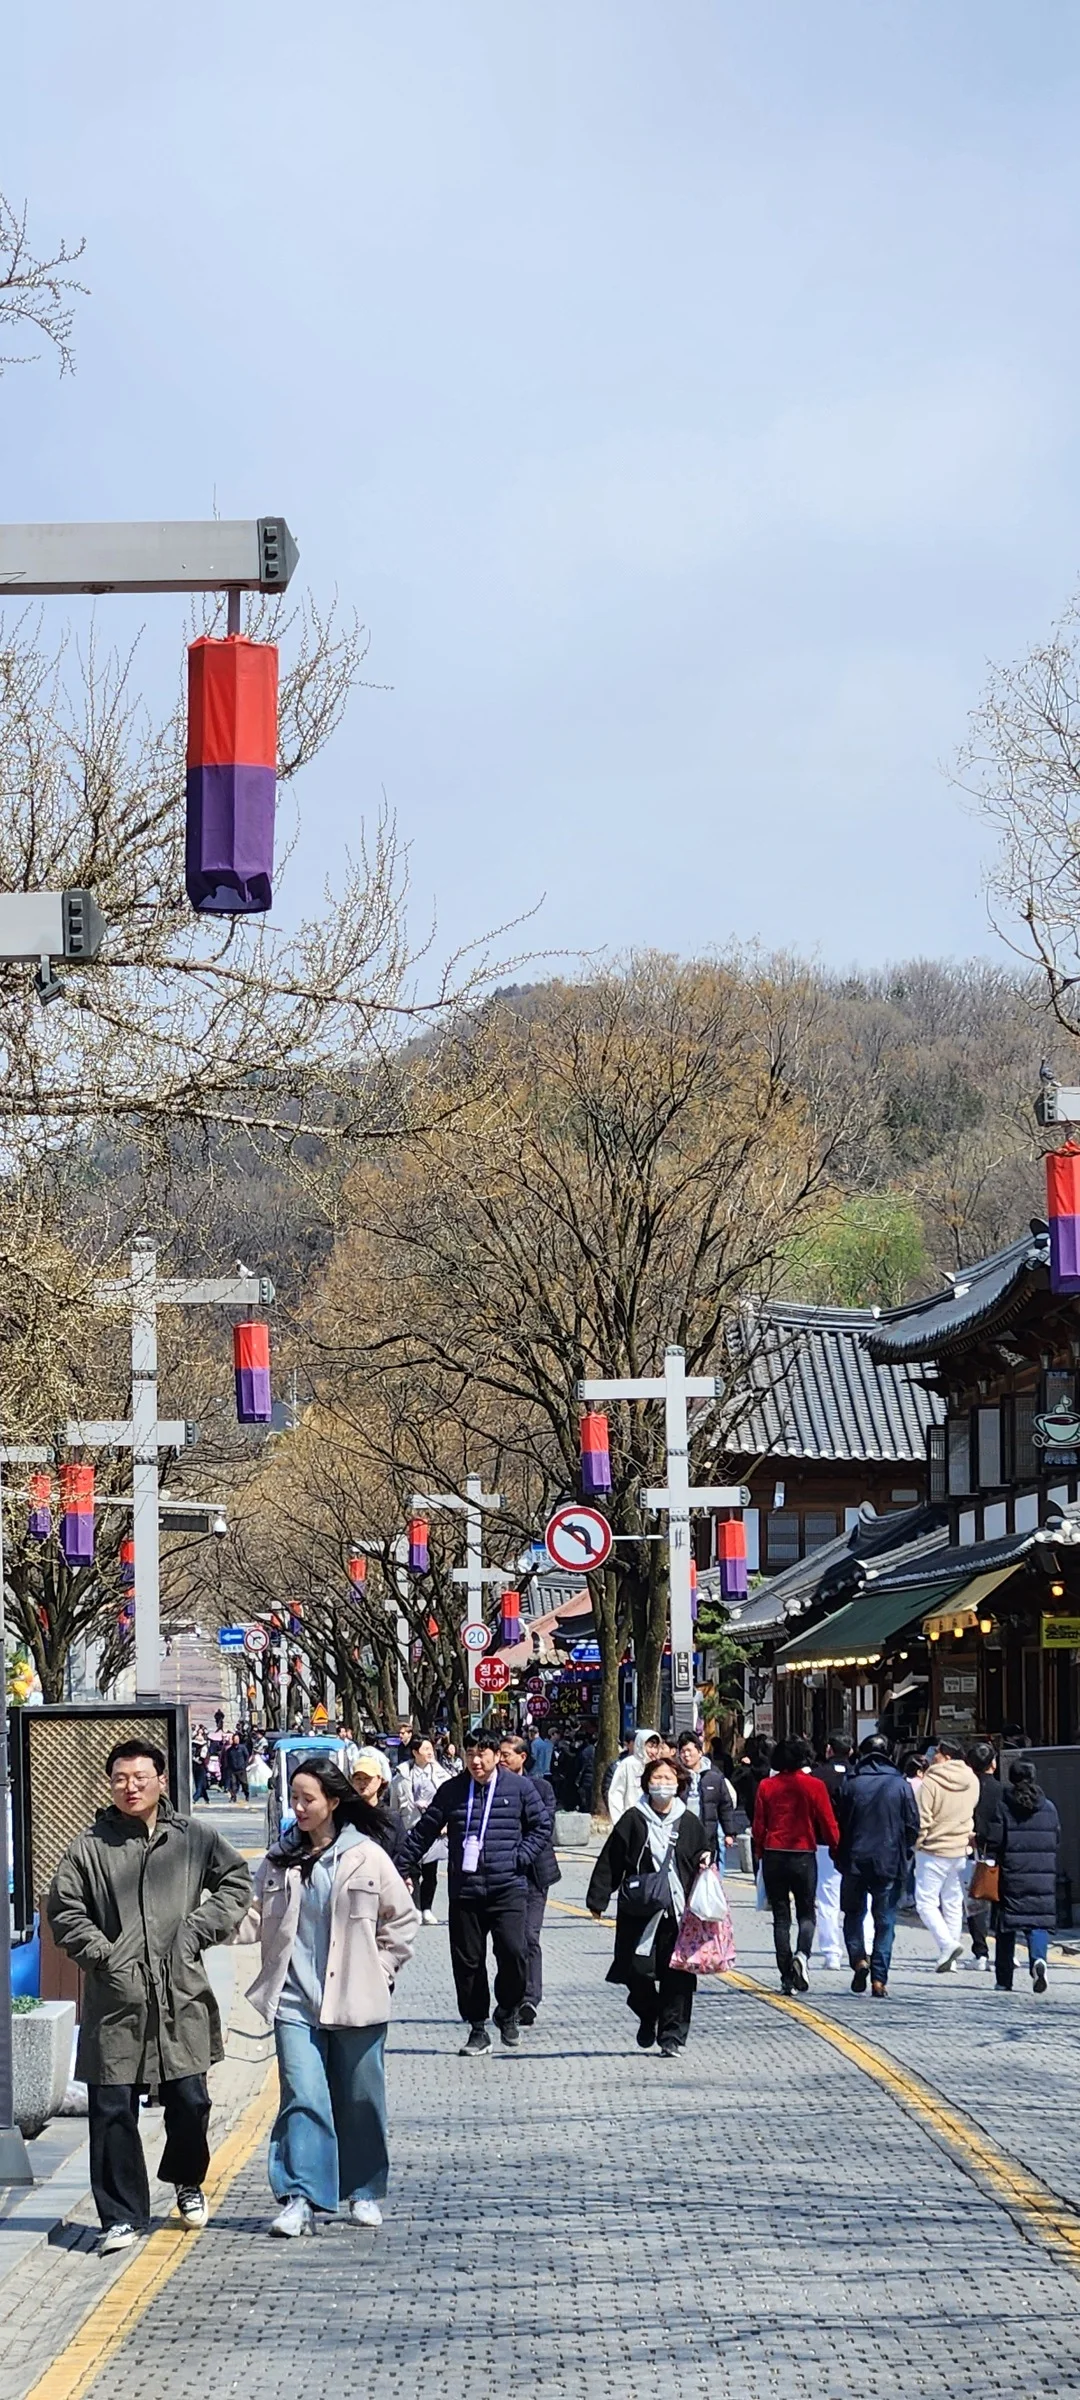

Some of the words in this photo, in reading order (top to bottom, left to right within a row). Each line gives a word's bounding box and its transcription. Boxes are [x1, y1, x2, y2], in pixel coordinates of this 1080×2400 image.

[468, 1631, 485, 1644] 20
[479, 1663, 505, 1677] 정지
[479, 1678, 505, 1688] STOP
